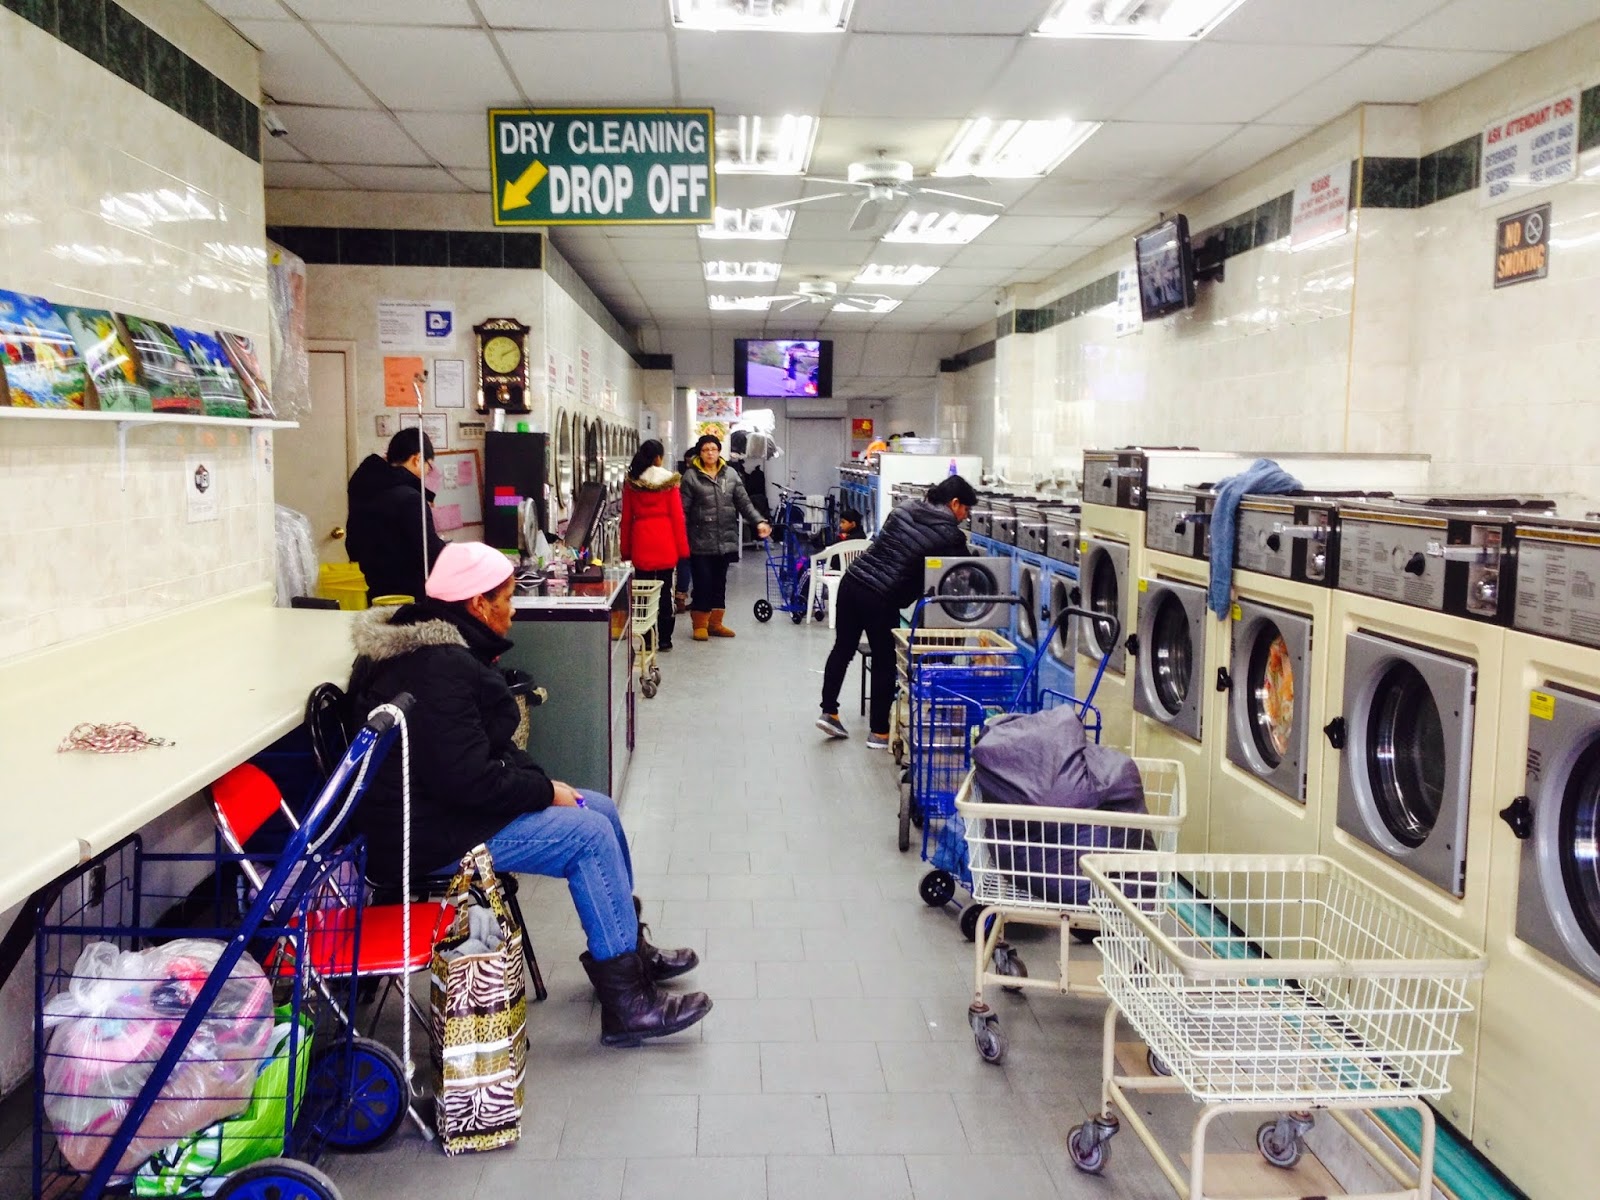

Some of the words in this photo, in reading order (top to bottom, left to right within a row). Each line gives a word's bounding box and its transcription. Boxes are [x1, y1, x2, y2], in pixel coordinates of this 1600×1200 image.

[1506, 105, 1552, 137] ATTENDANT
[1554, 97, 1574, 118] FOR
[500, 121, 555, 155] DRY
[567, 119, 706, 154] CLEANING
[548, 163, 634, 214] DROP
[647, 162, 708, 214] OFF
[1504, 220, 1522, 249] NO
[1497, 243, 1546, 279] SMOKING
